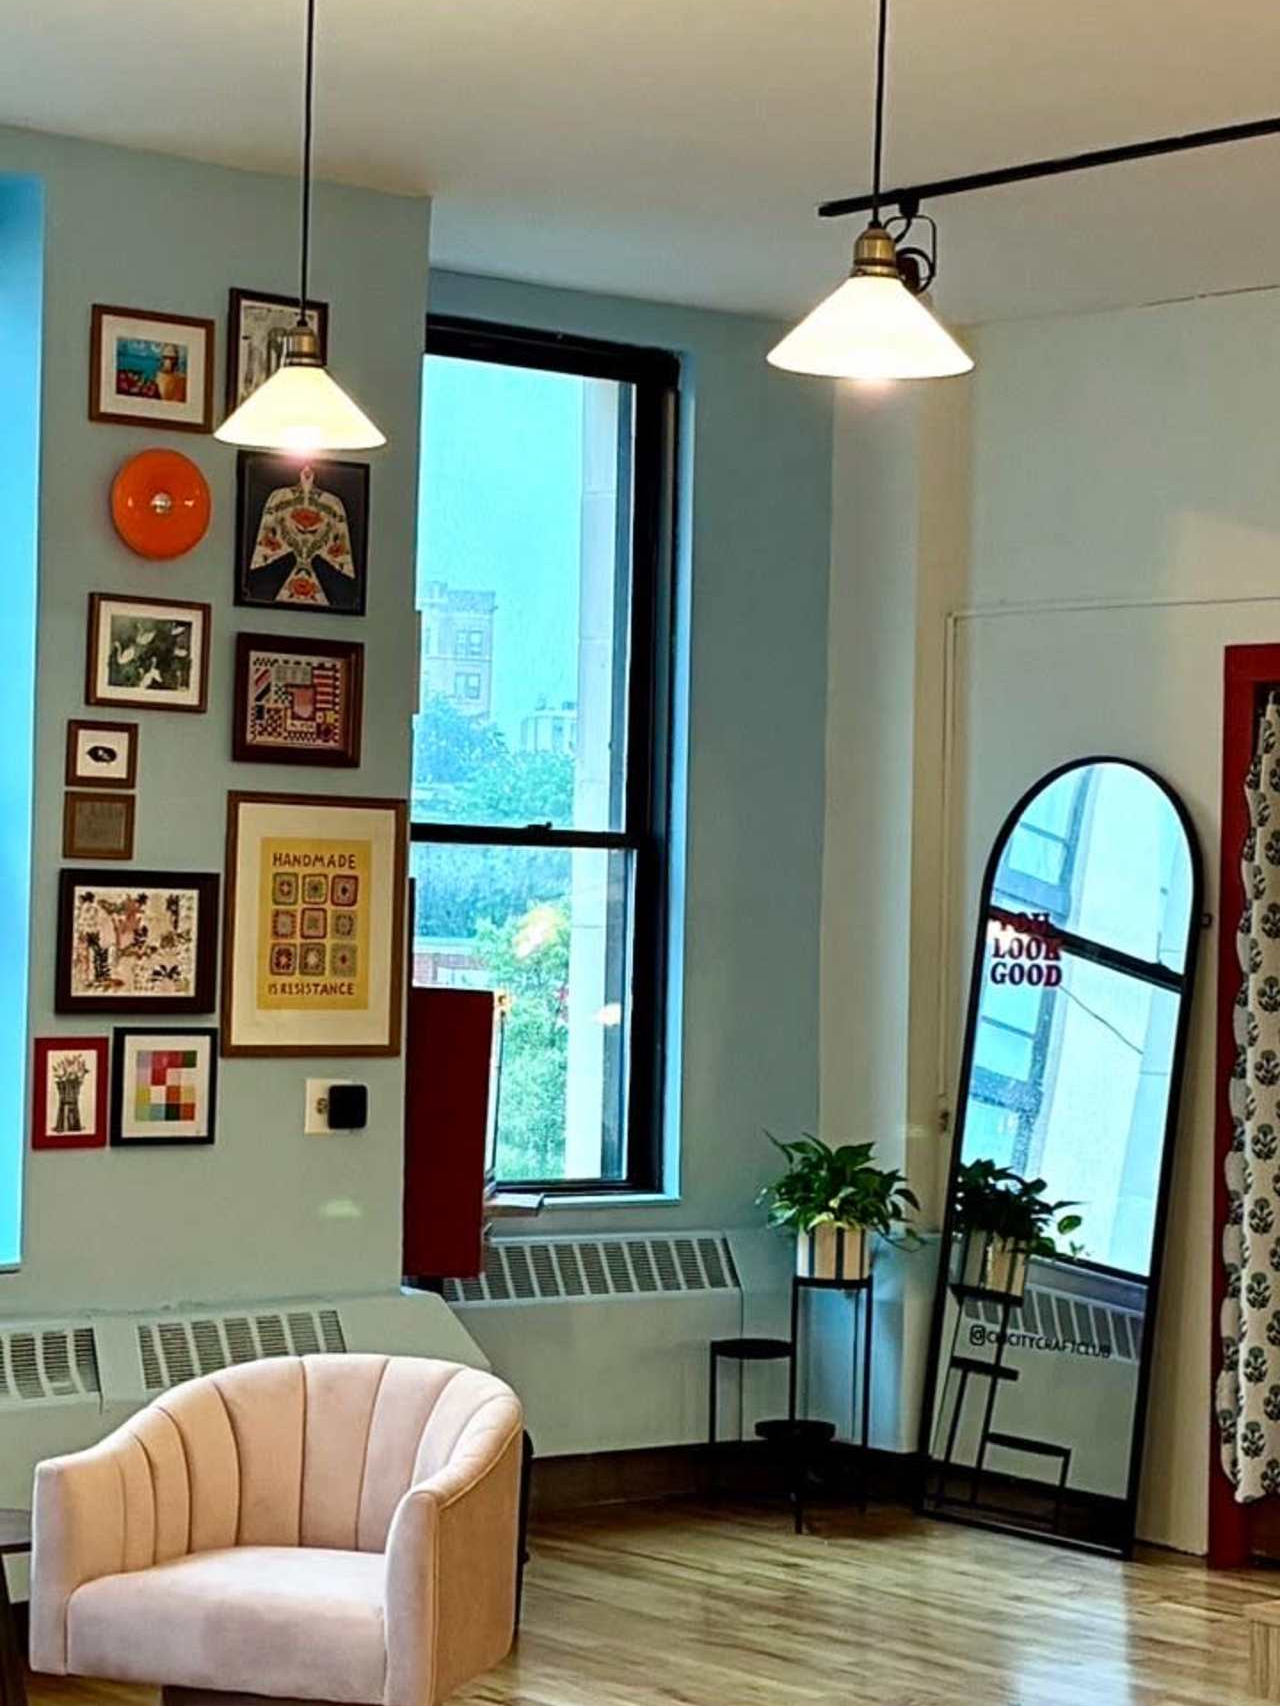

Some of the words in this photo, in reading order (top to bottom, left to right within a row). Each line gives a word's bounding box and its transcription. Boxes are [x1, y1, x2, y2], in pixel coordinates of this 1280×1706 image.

[272, 852, 357, 869] HANDMADE
[990, 936, 1062, 962] LOOK
[990, 961, 1063, 987] GOOD
